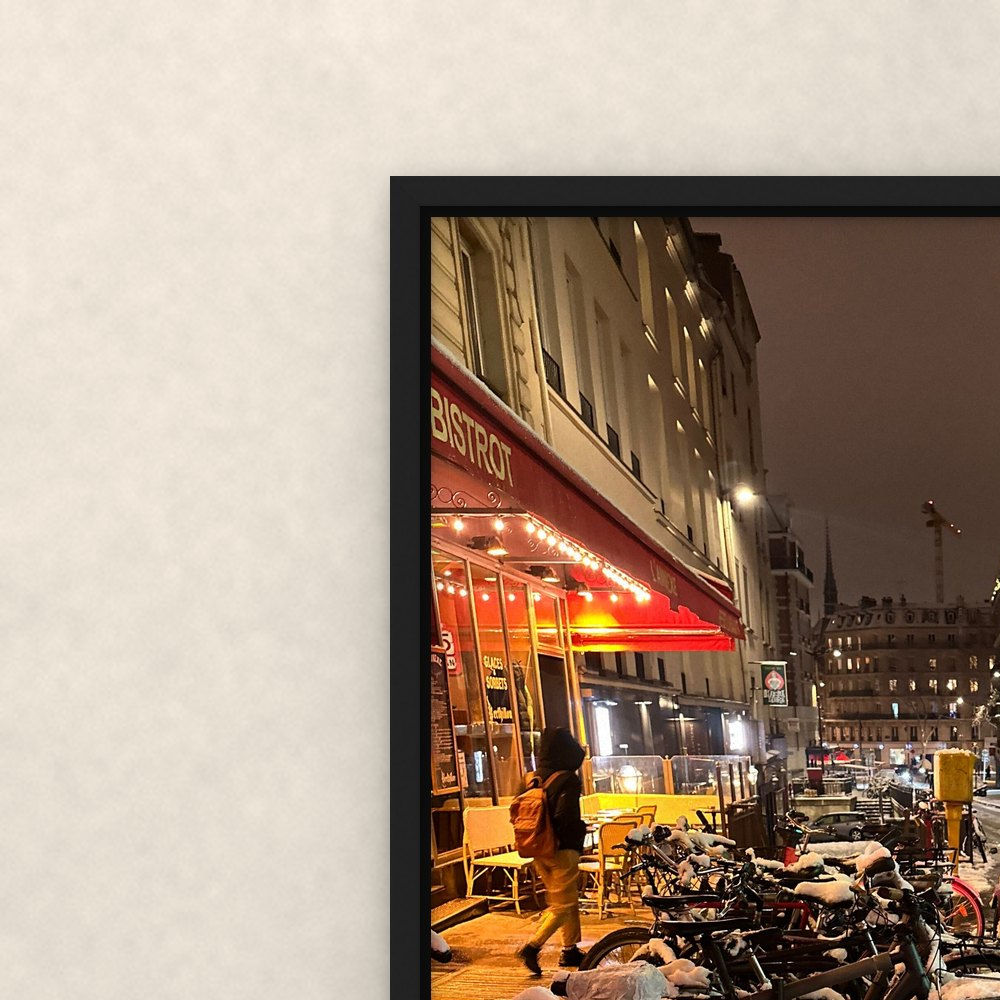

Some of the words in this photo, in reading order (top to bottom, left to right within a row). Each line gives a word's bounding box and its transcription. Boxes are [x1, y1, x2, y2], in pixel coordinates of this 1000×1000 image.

[431, 386, 513, 487] BISTROT
[483, 655, 503, 670] GLACES
[485, 675, 508, 690] SORBETS
